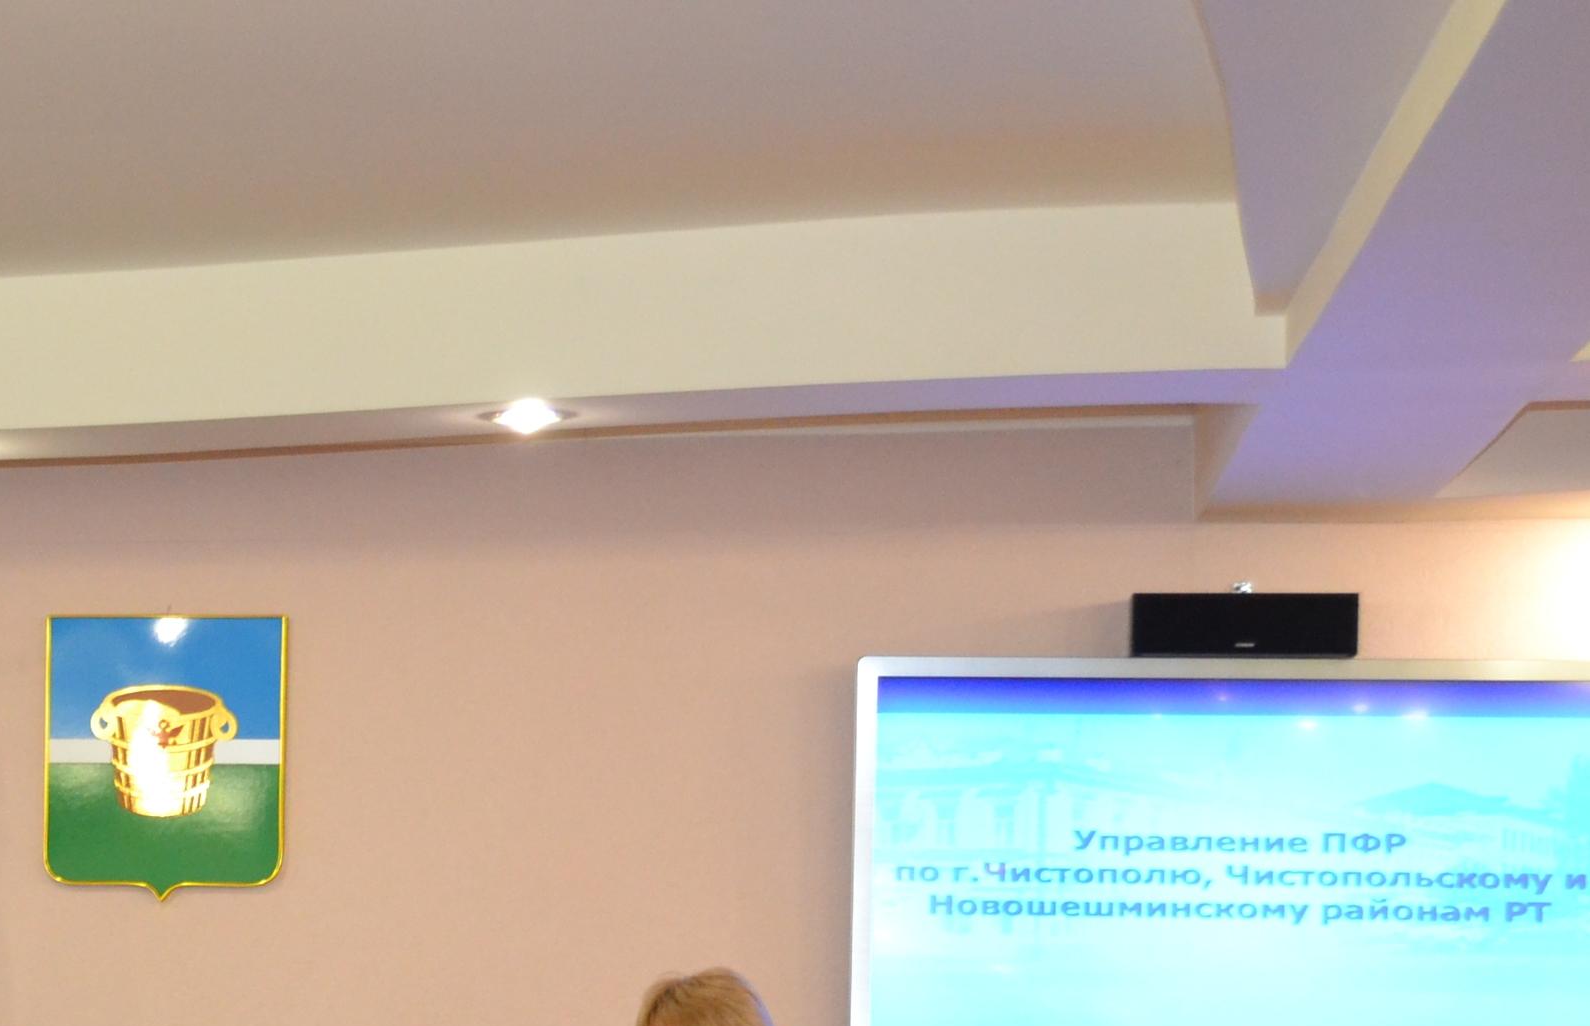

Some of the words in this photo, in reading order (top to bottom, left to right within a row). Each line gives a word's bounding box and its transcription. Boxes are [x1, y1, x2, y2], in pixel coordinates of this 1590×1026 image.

[1073, 829, 1308, 856] Управление
[1323, 832, 1408, 854] ПФР
[895, 865, 939, 882] по
[951, 861, 1213, 889] г.Чистополю,
[1225, 865, 1552, 895] Чистопольскому
[1565, 873, 1587, 890] и
[929, 894, 1308, 925] Новошешминскому
[1322, 899, 1491, 925] районам
[1505, 902, 1552, 922] РТ
